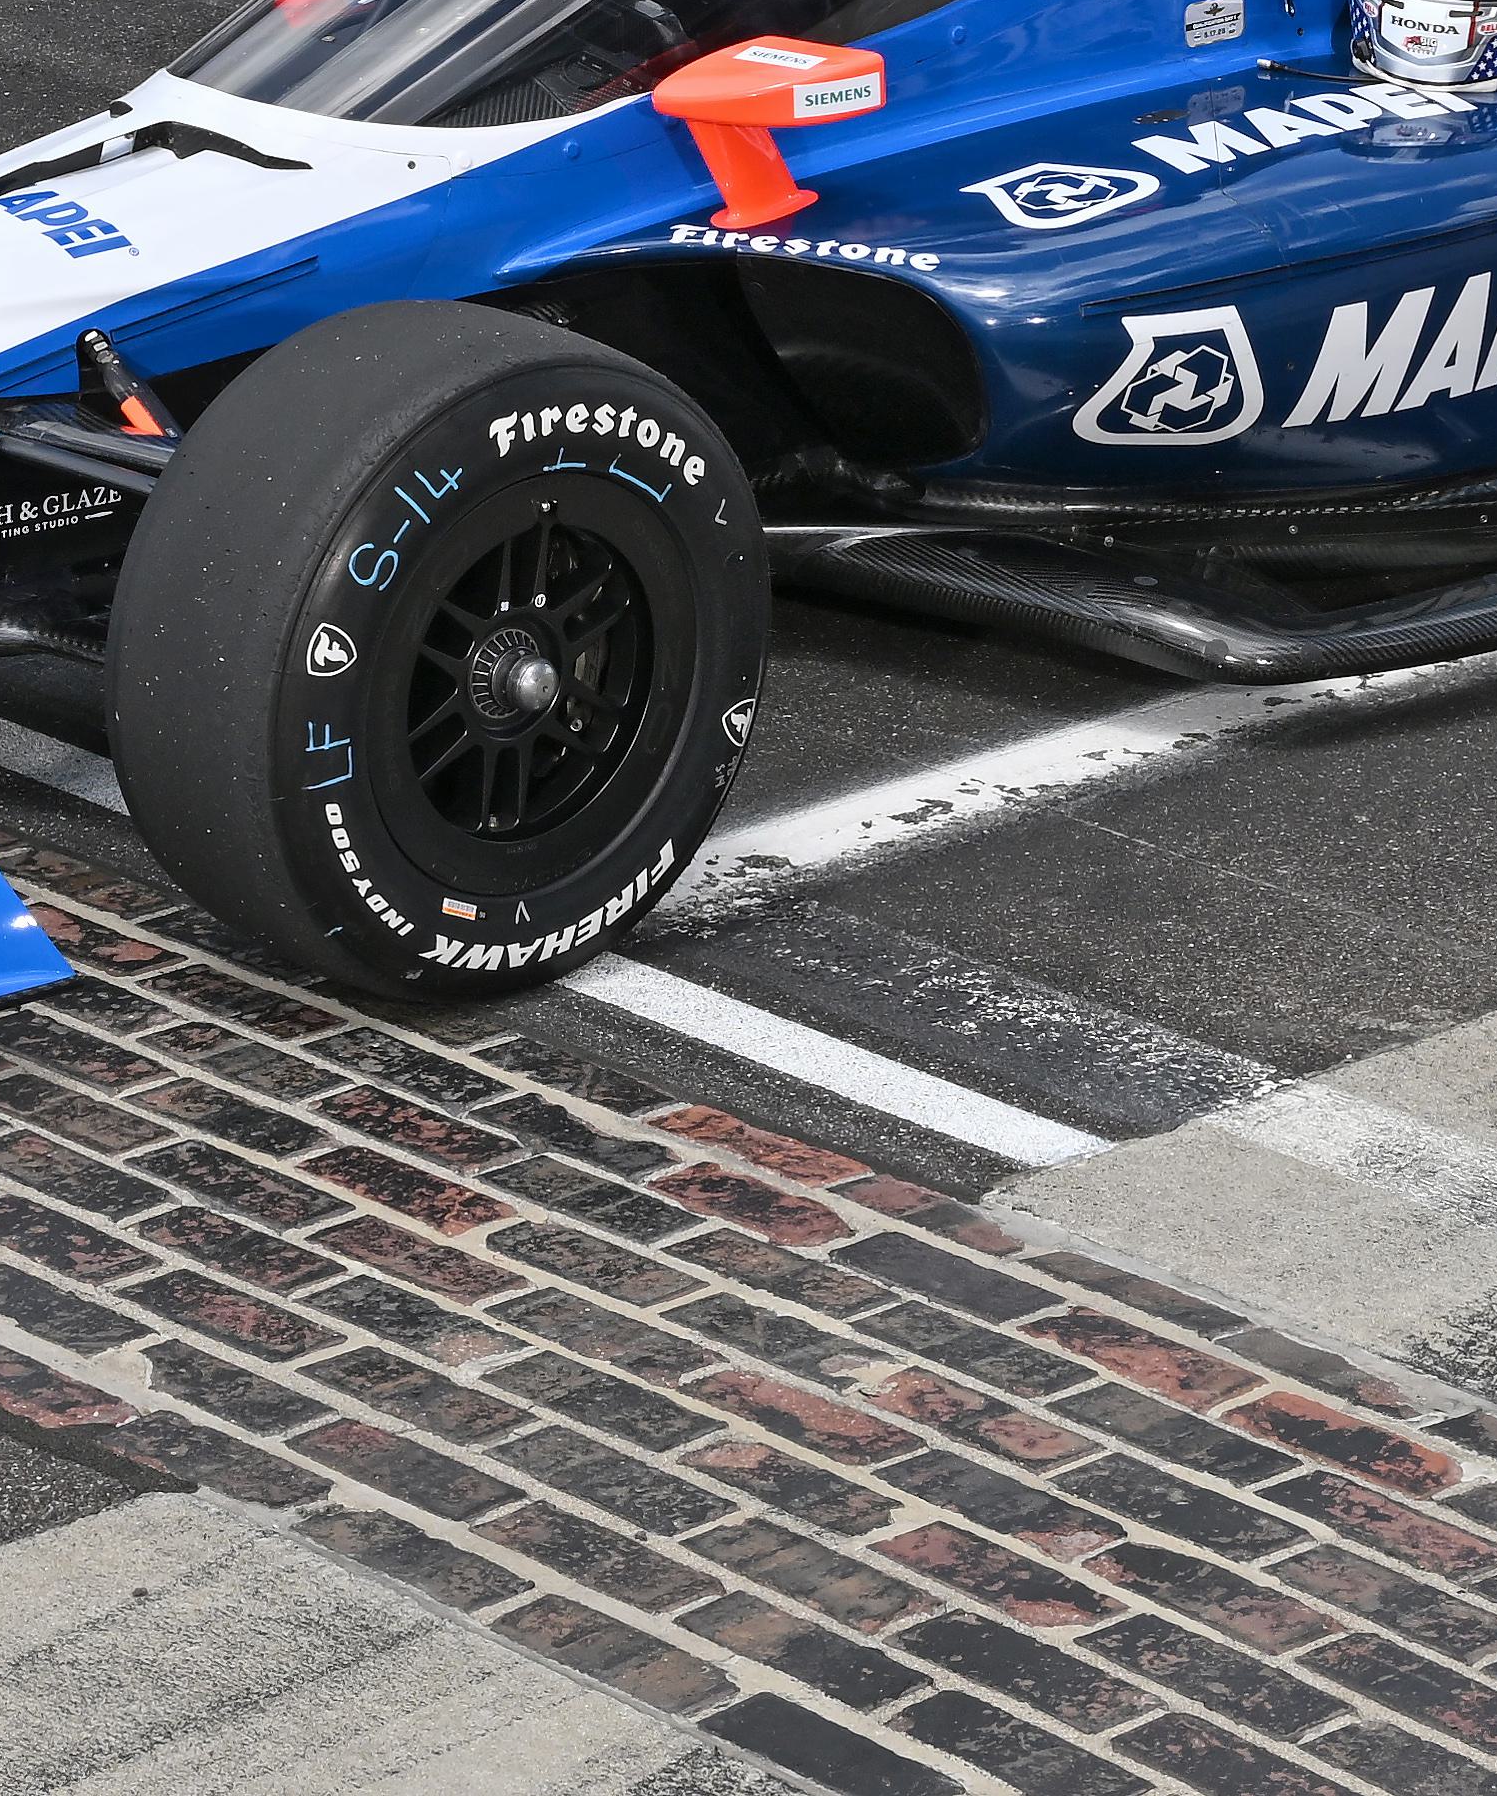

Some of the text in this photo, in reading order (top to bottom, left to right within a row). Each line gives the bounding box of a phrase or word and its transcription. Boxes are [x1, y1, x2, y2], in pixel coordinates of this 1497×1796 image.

[1390, 14, 1460, 35] HONDA
[751, 50, 810, 65] SIEMENS
[804, 85, 872, 107] SIEMENS
[1131, 82, 1477, 174] MAPEI
[669, 224, 941, 272] Firestone
[488, 403, 706, 487] Firestone
[19, 501, 39, 521] &
[42, 486, 122, 516] GLAZE
[34, 514, 80, 533] STUDIO
[348, 467, 464, 593] S-14
[302, 721, 354, 792] LF
[417, 838, 676, 972] FIREHAWK
